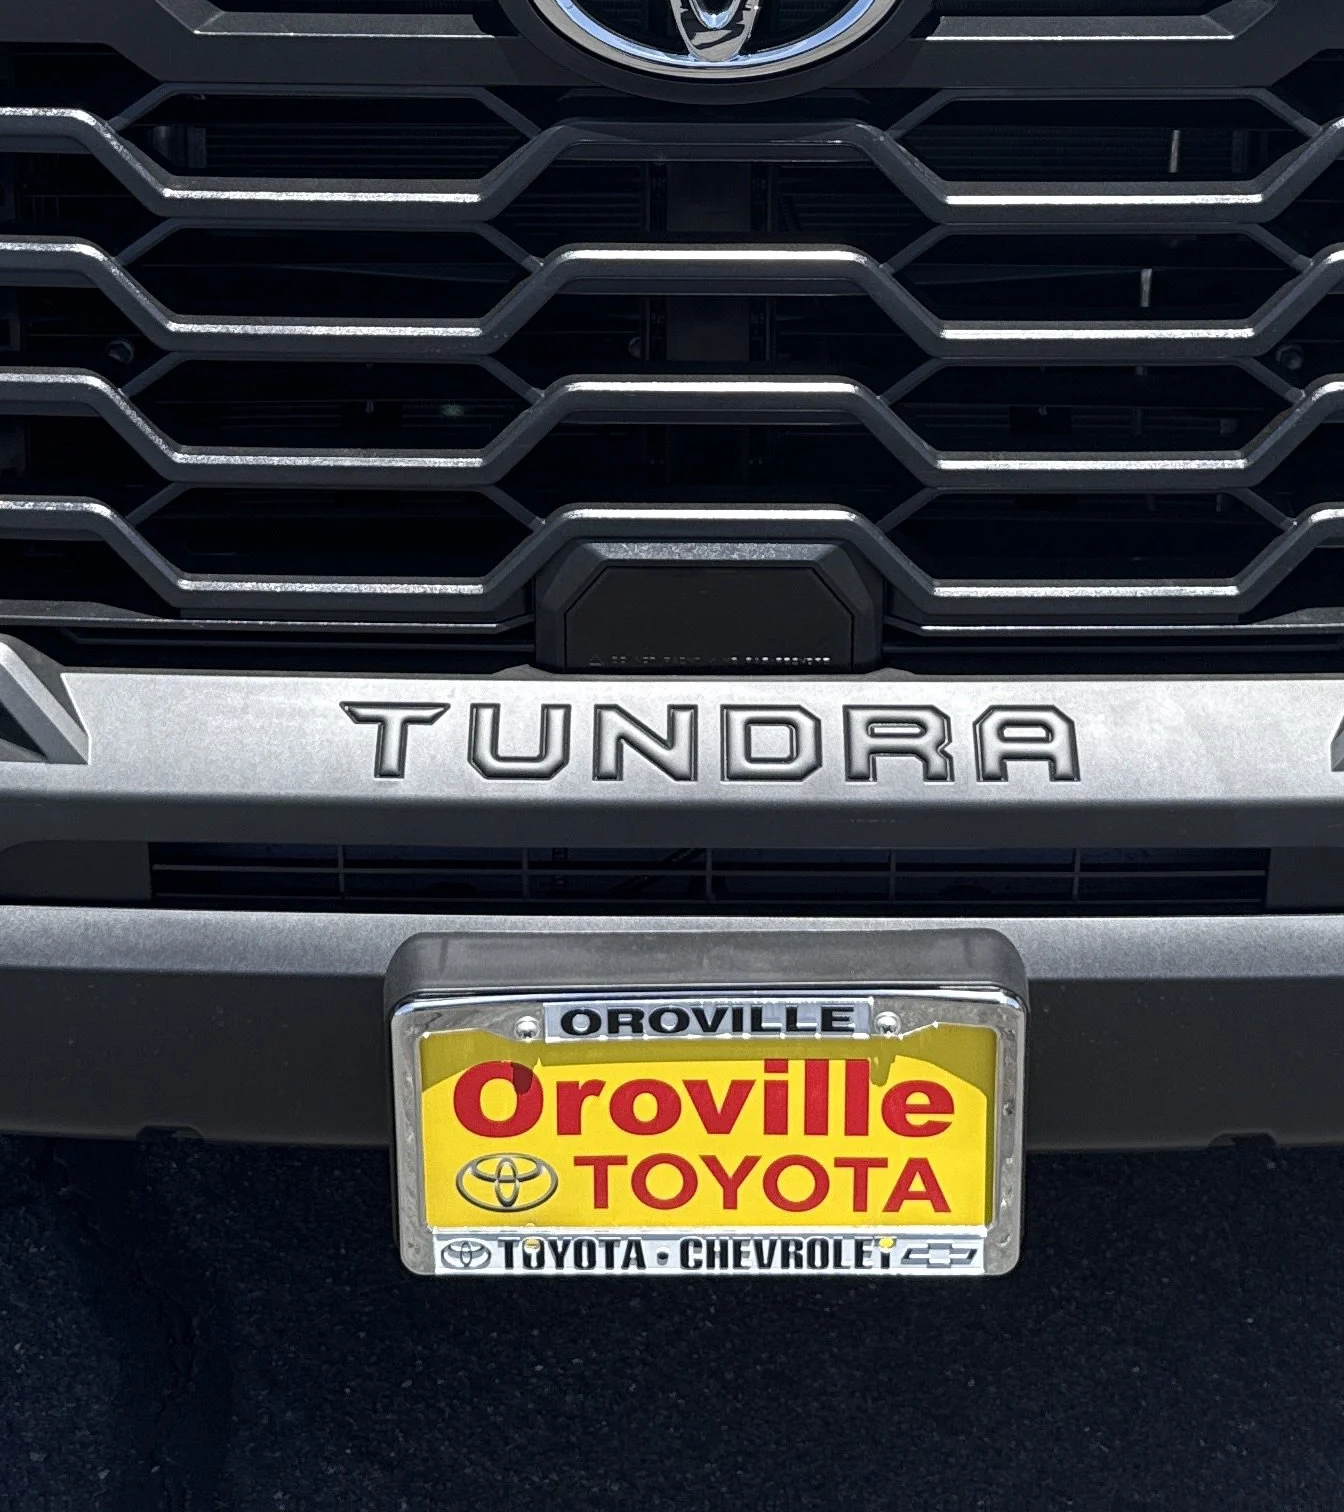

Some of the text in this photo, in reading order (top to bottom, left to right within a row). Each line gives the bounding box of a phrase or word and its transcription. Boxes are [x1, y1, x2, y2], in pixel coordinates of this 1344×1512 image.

[339, 702, 1081, 783] TUNDRA
[560, 1006, 856, 1035] OROVILLE
[453, 1058, 955, 1138] Oroville
[573, 1154, 952, 1214] TOYOTA
[497, 1238, 647, 1271] TOYOTA
